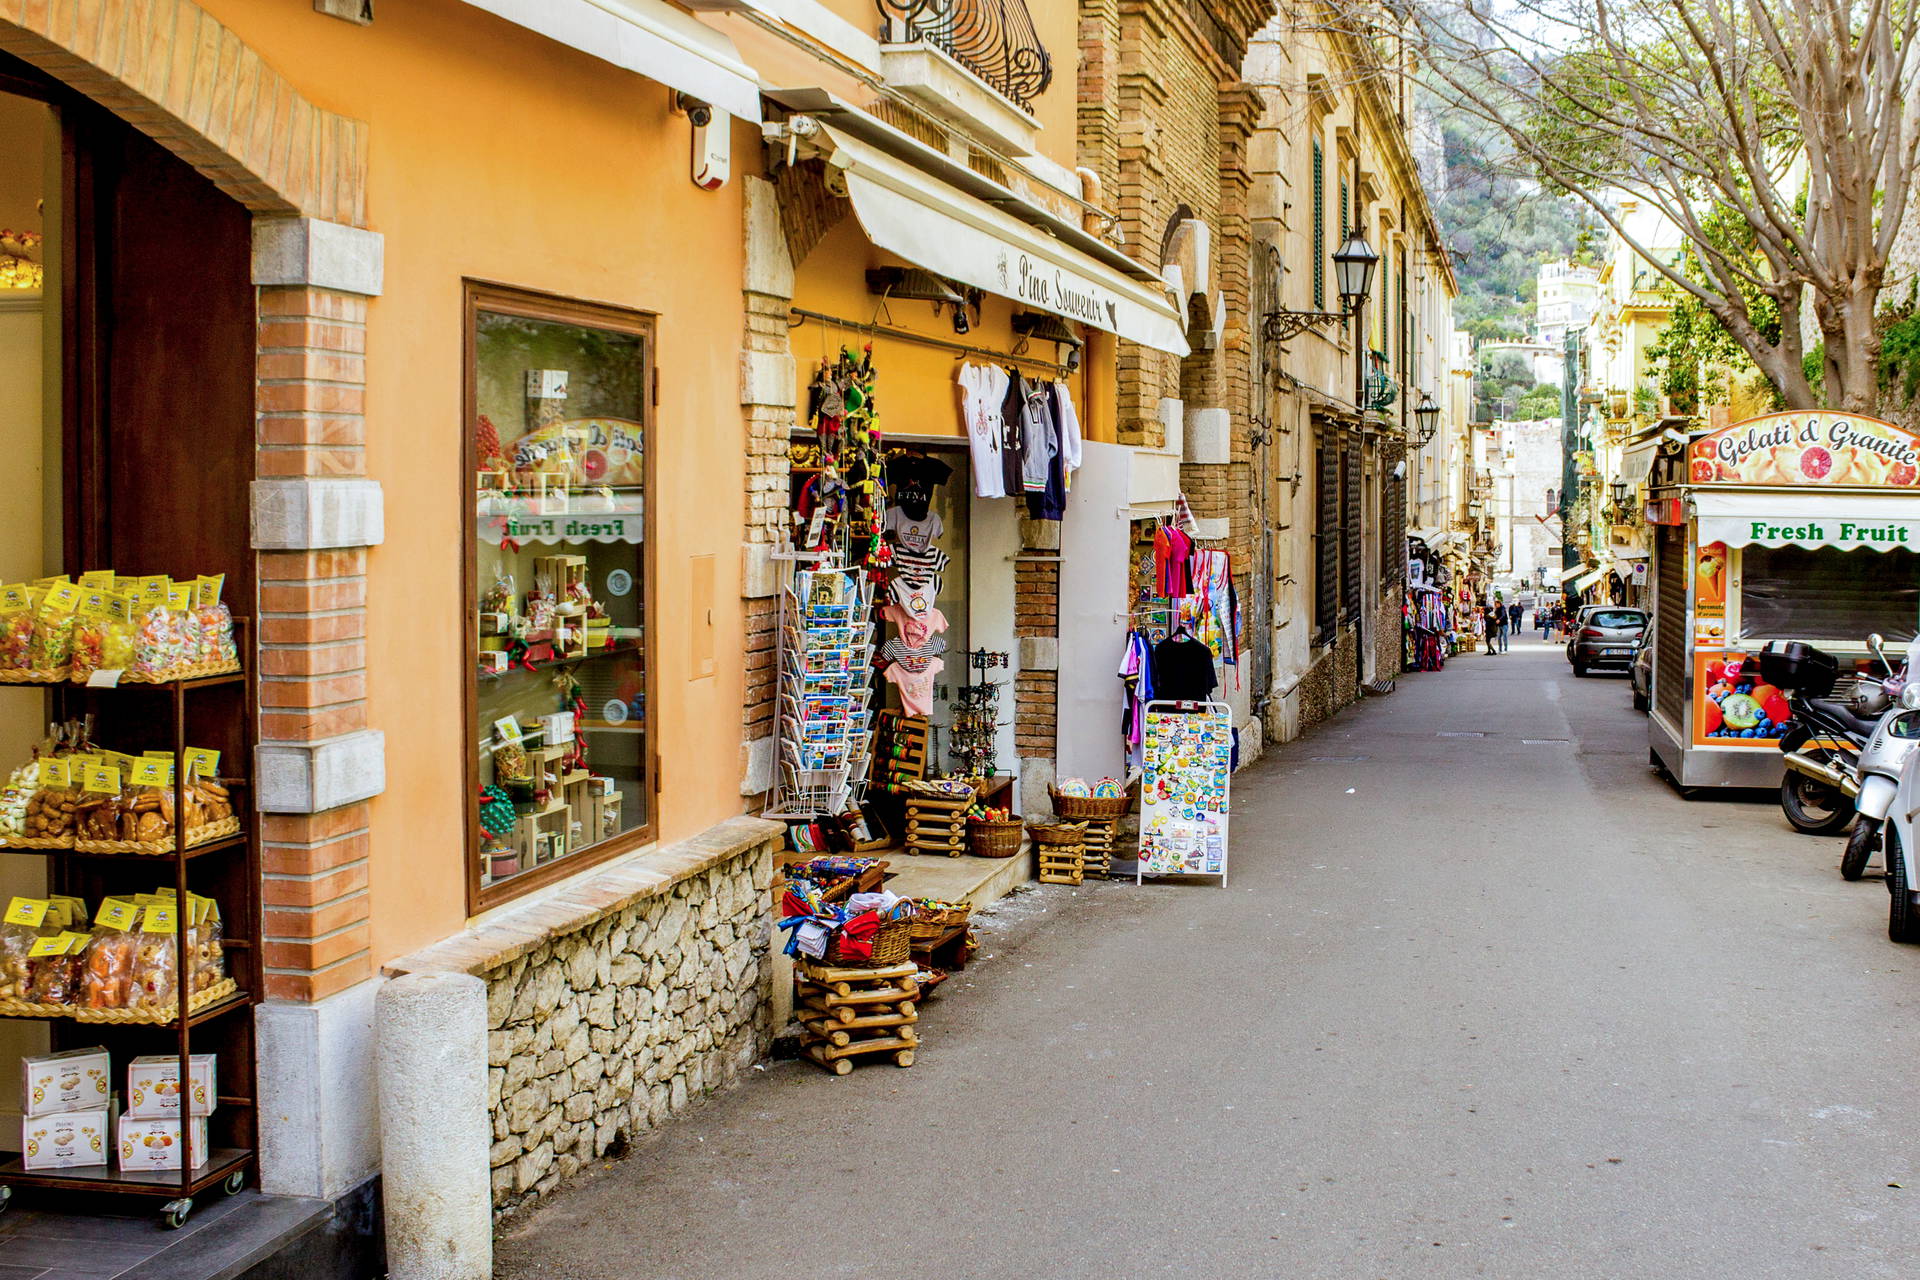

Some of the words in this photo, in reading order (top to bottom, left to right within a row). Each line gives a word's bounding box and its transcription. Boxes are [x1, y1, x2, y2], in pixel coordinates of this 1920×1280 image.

[1018, 254, 1050, 304] Pino
[1055, 269, 1102, 323] Souvenir
[1718, 424, 1792, 467] Gelati
[1828, 421, 1916, 465] Granite
[897, 491, 928, 502] ETNA
[1750, 522, 1824, 540] Fresh
[1839, 523, 1909, 542] Fruit
